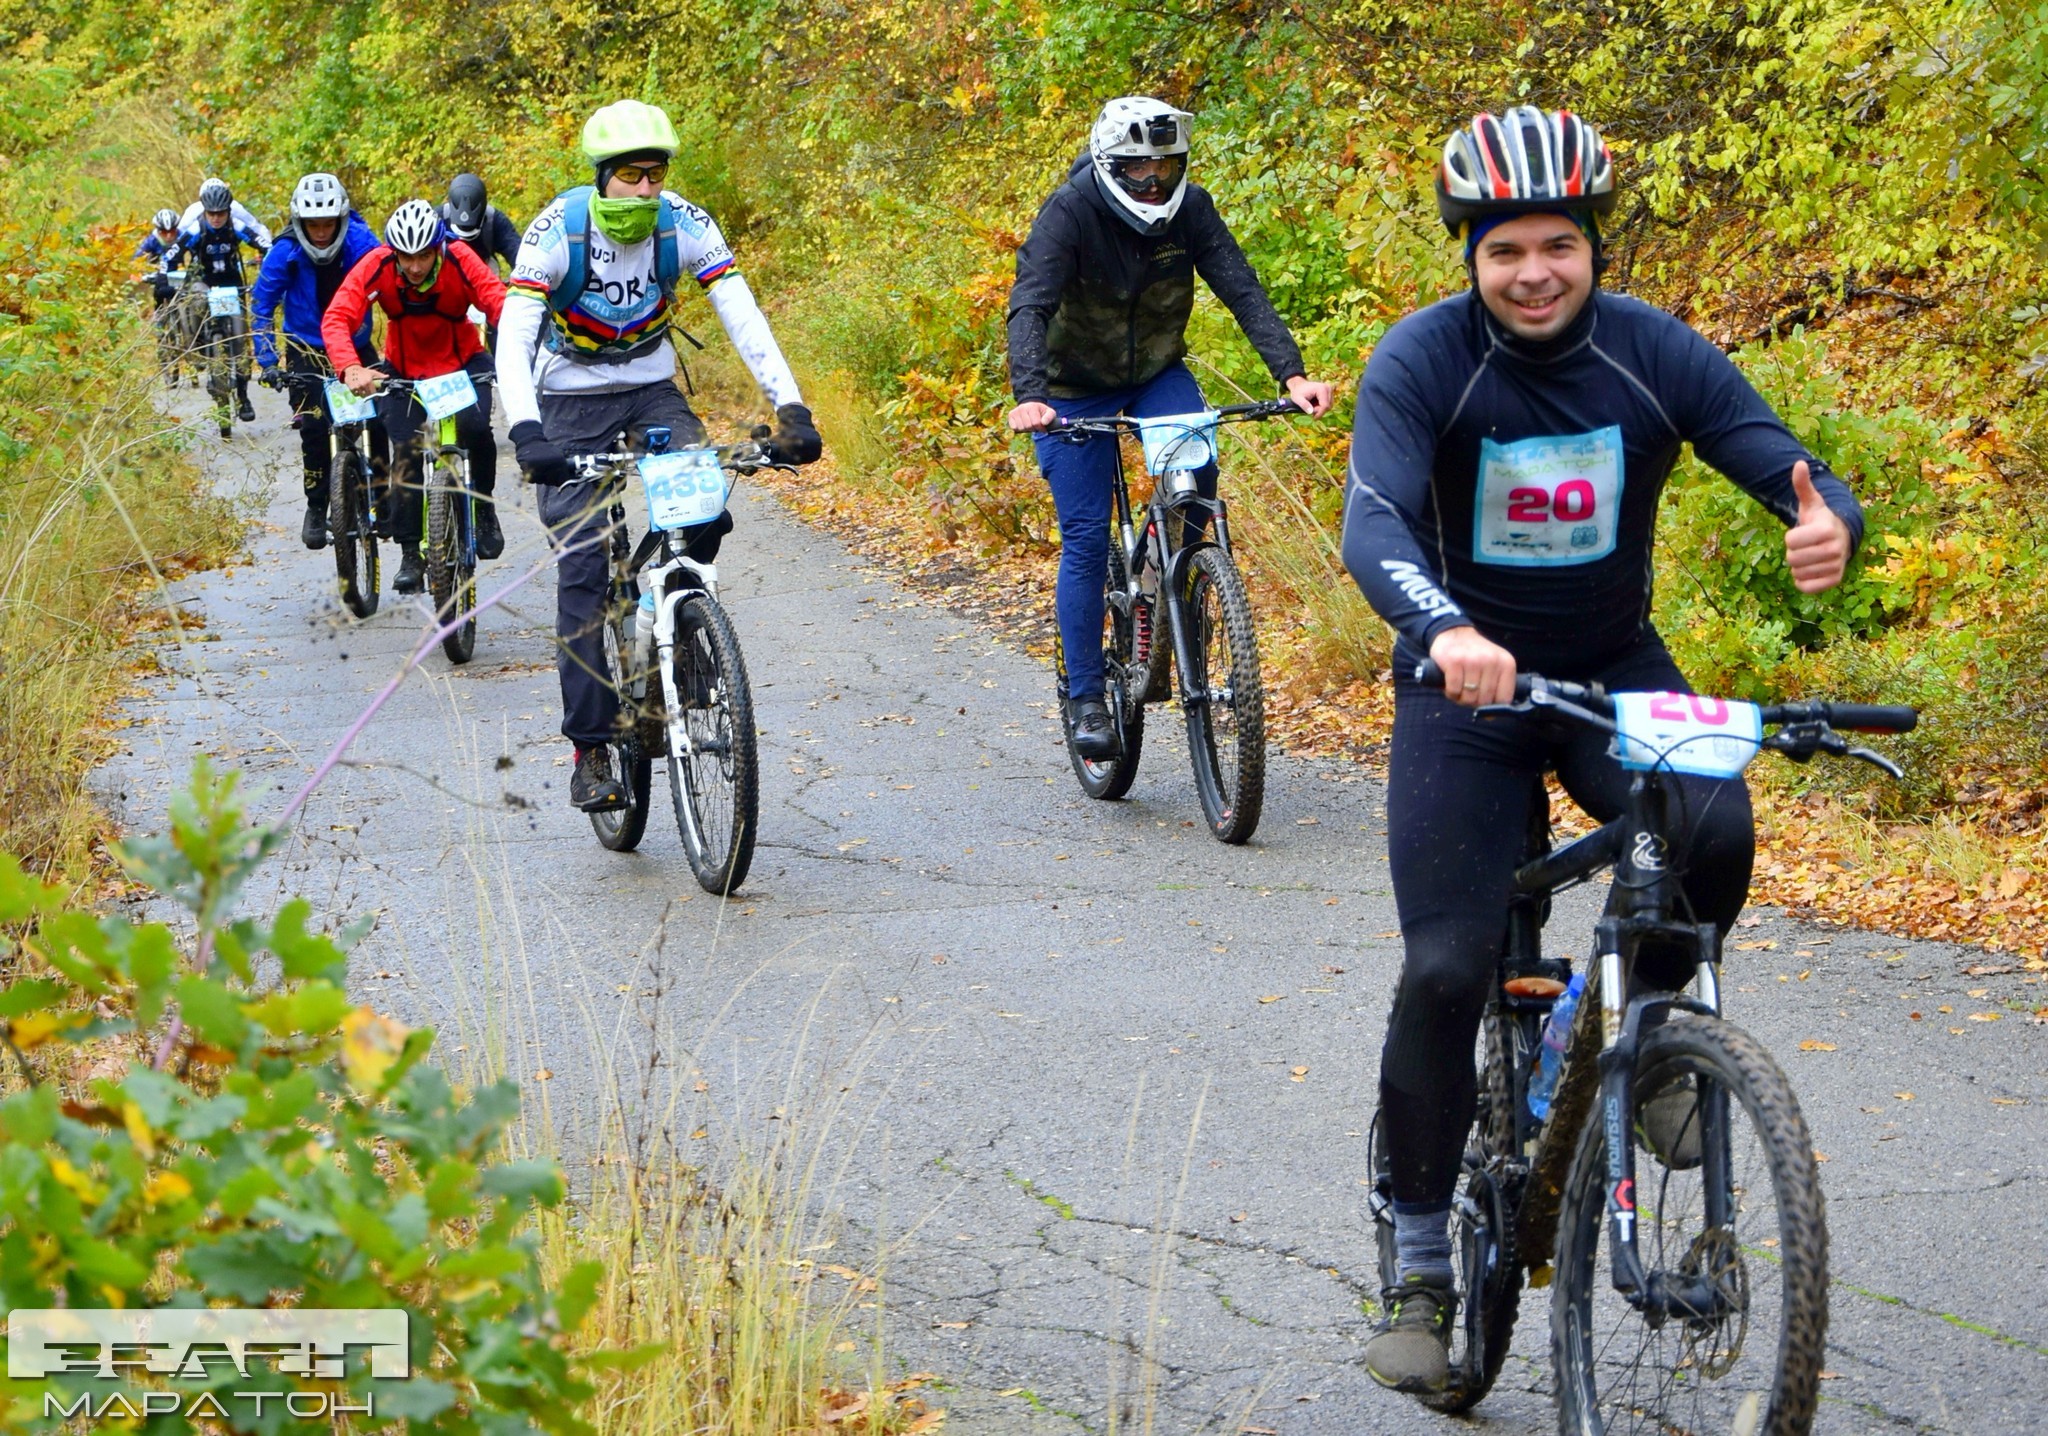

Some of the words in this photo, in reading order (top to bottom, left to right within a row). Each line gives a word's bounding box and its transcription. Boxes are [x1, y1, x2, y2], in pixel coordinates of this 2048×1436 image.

[591, 247, 616, 264] UCI
[650, 470, 720, 501] 438
[1507, 479, 1595, 523] 20
[1380, 559, 1462, 618] MUST
[1650, 691, 1729, 726] 20
